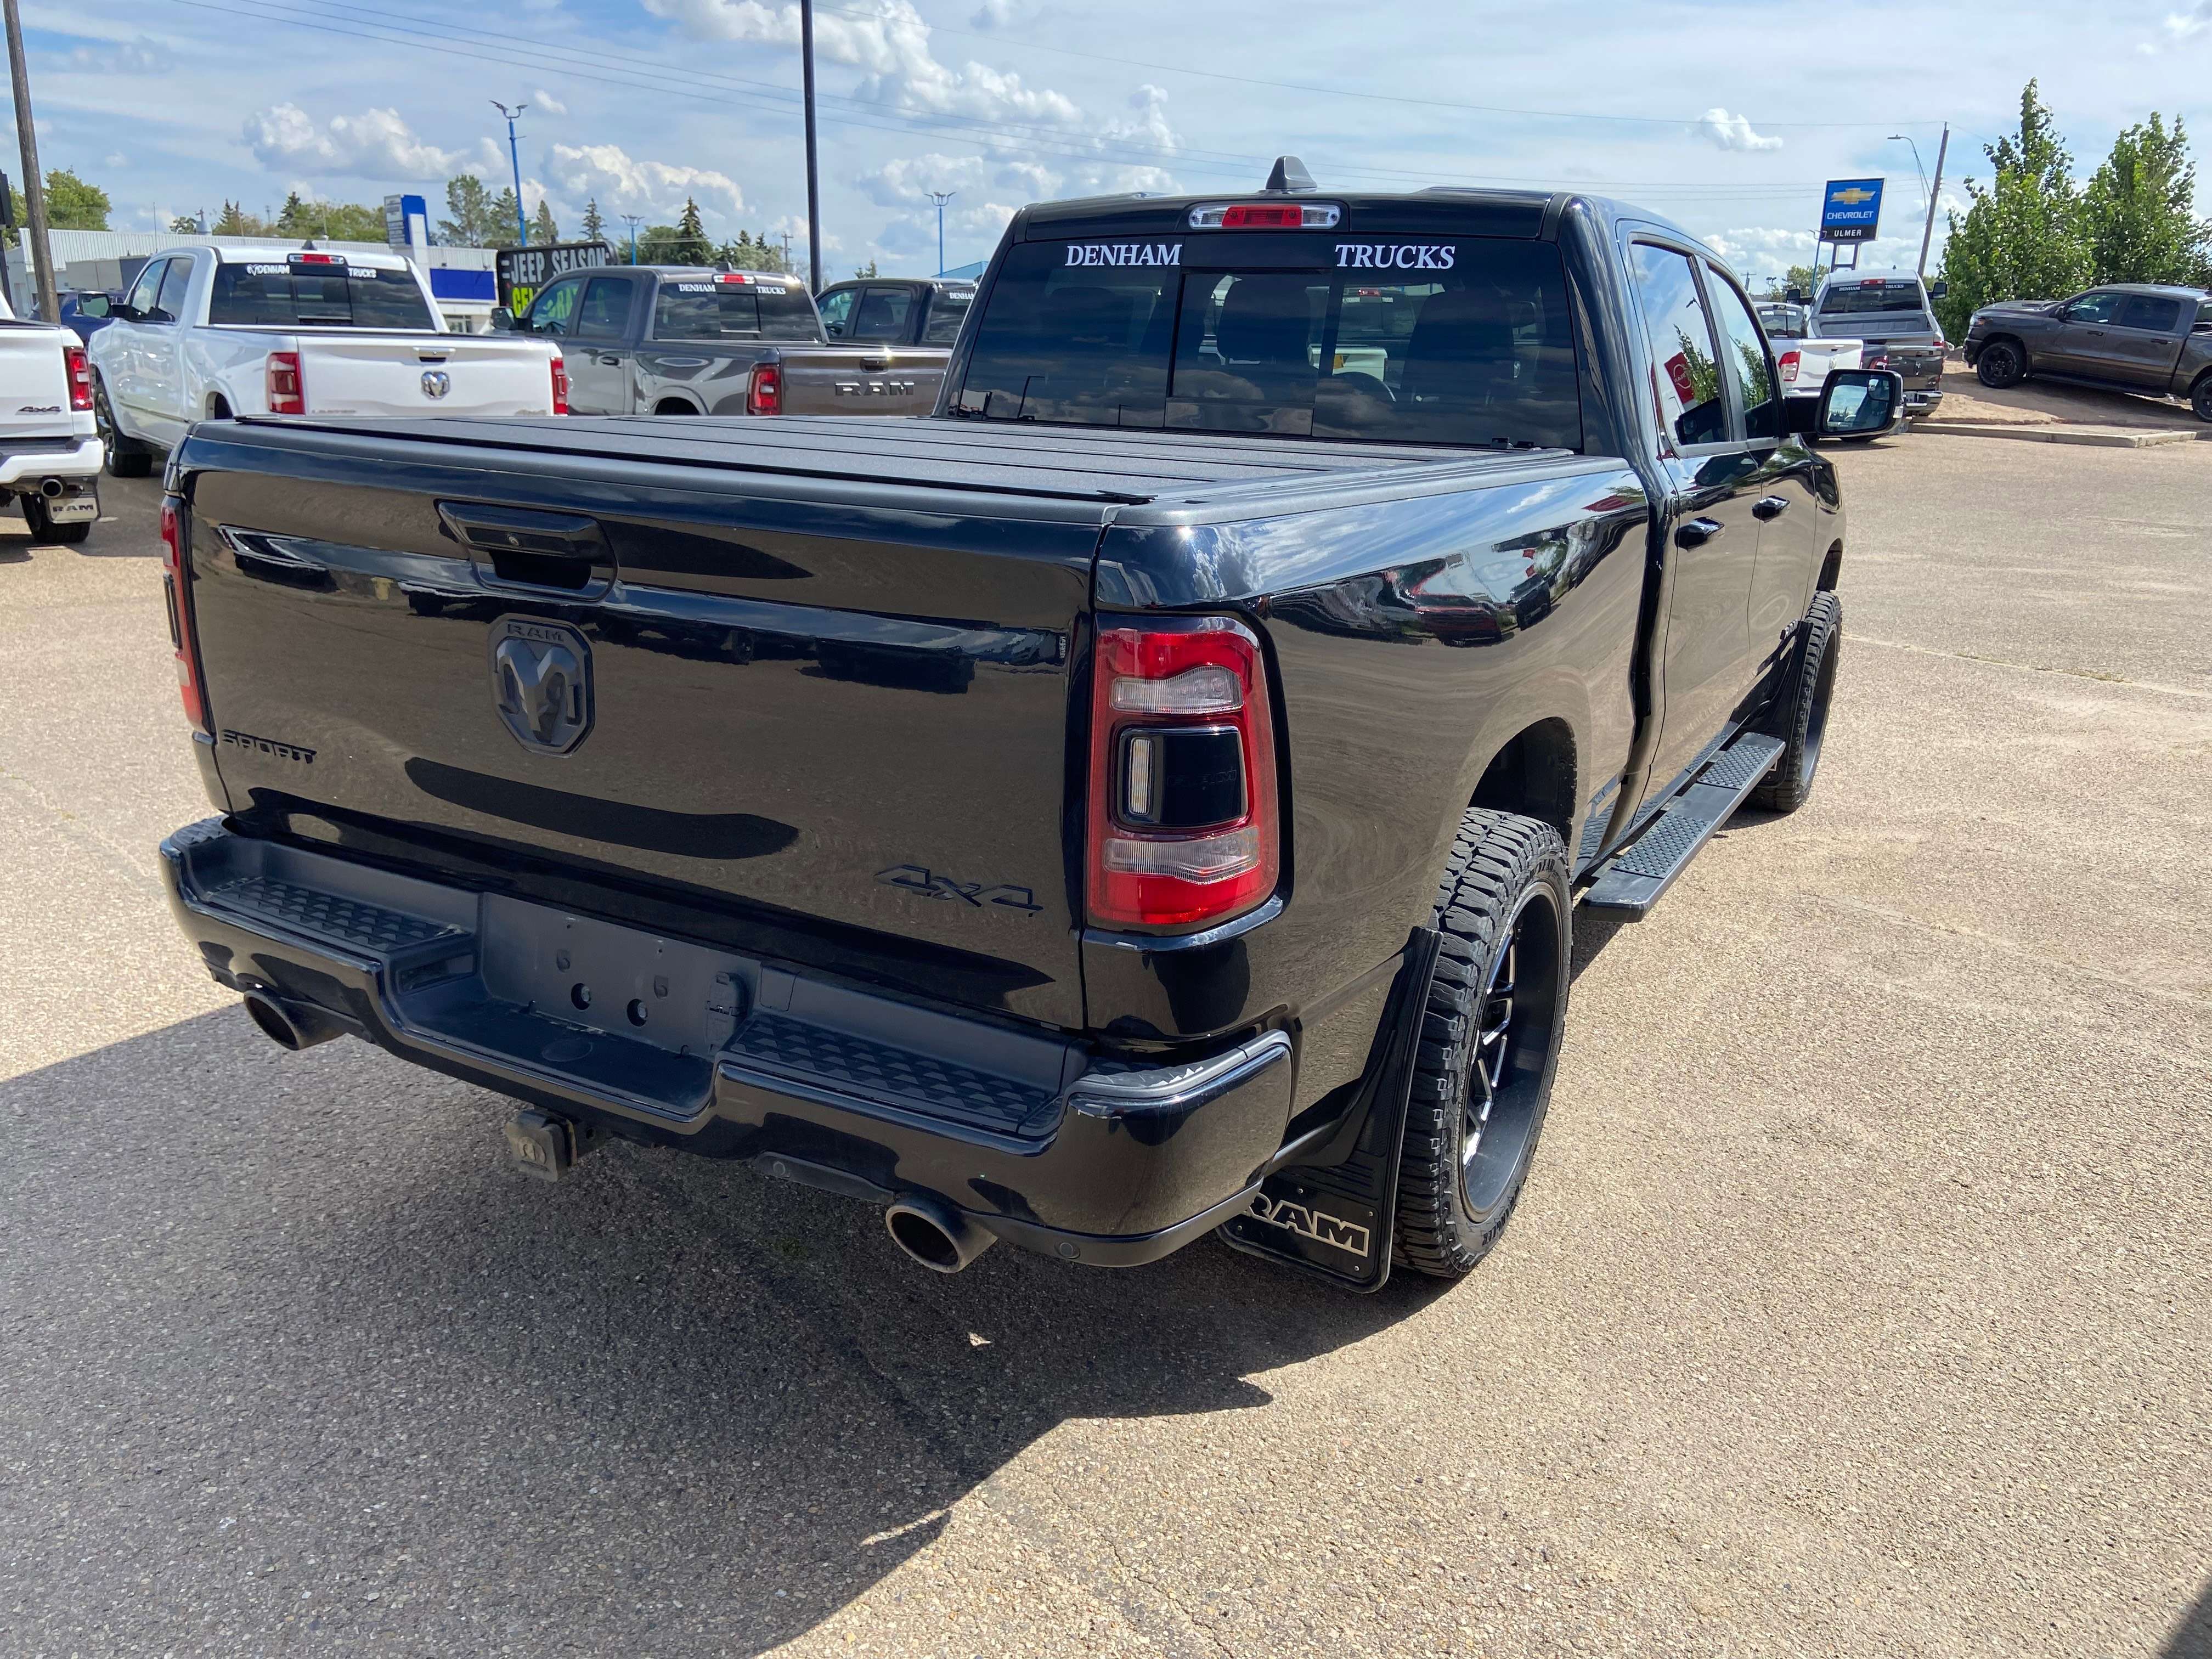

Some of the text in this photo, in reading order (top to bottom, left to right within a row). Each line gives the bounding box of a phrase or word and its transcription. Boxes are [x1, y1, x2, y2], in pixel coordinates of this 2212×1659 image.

[1827, 211, 1874, 219] CHEVROLET
[1064, 244, 1455, 269] DENHAM TRUCKS
[258, 264, 377, 278] DENHAM TRUCKS
[511, 247, 606, 284] JEEP SEASON
[678, 284, 786, 294] DENHAM TRUCKS
[835, 381, 915, 396] RAM
[507, 624, 565, 642] RAM
